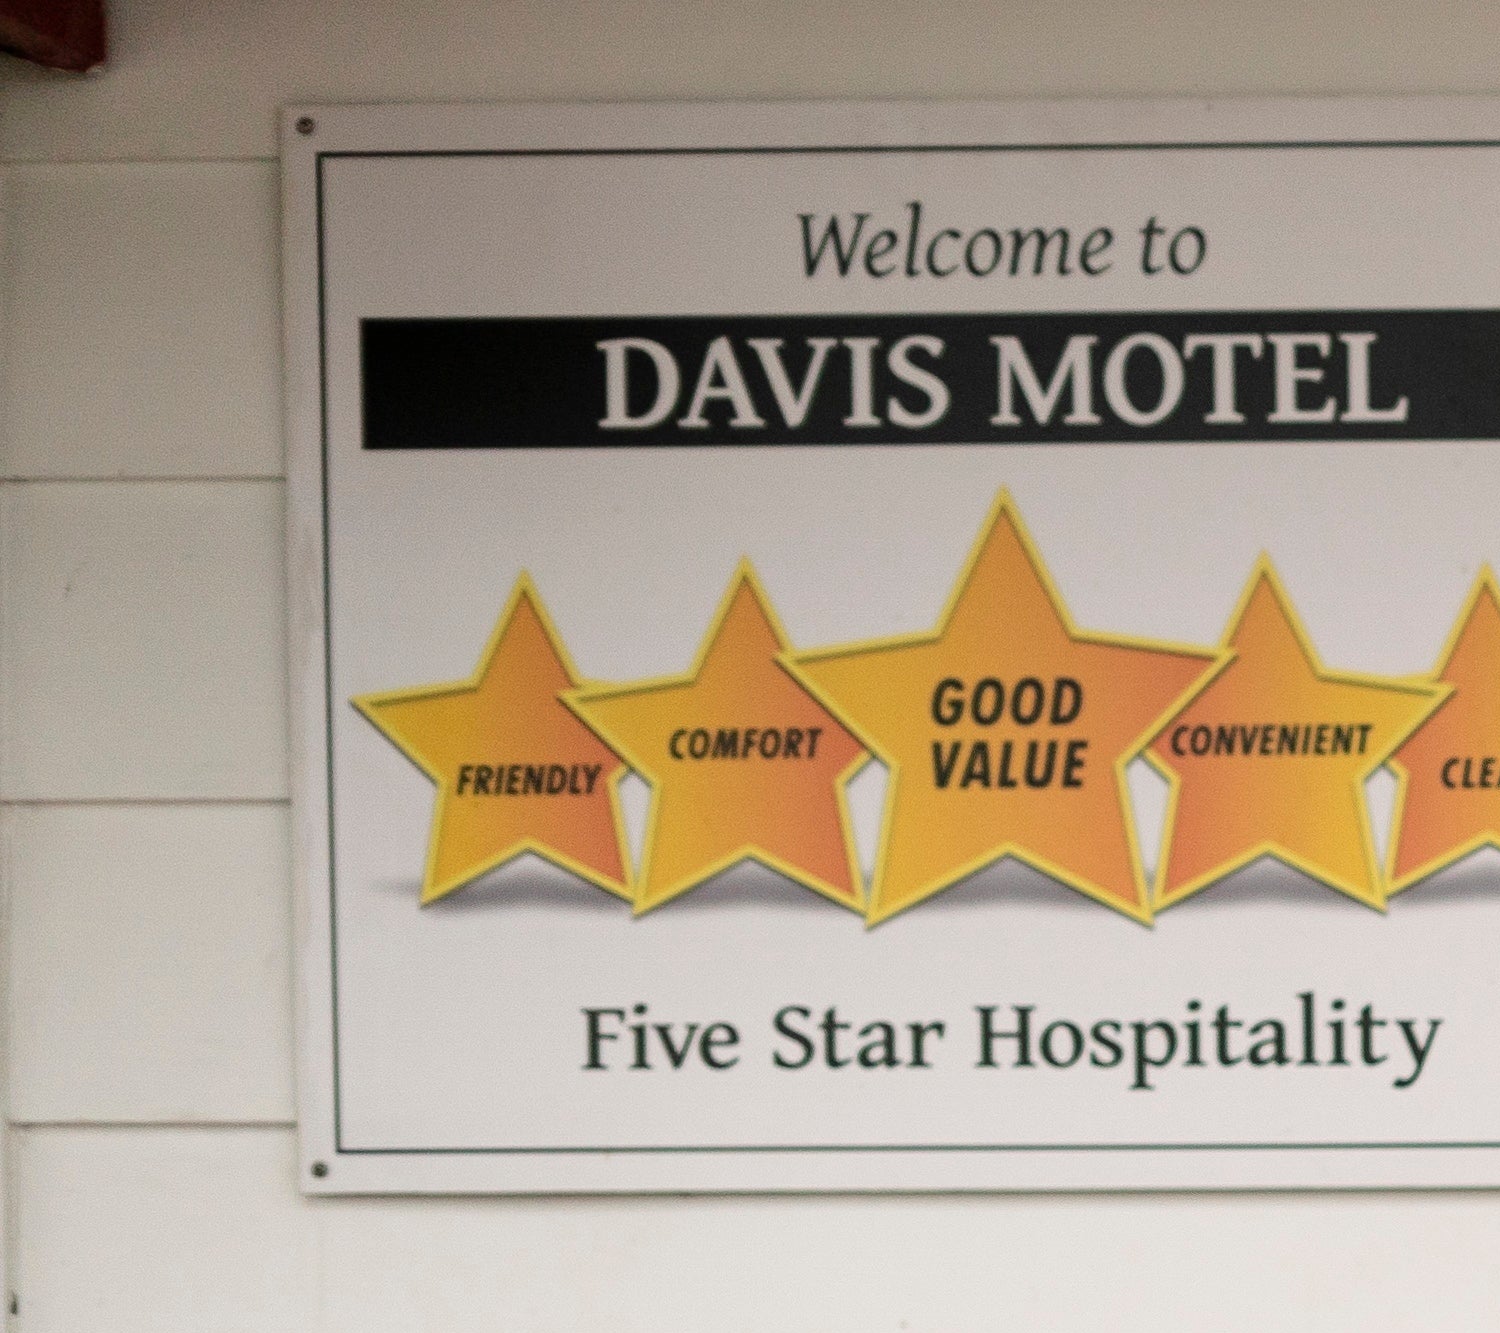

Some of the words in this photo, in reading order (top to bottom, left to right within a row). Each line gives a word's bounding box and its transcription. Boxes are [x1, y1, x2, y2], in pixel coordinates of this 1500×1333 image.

[798, 200, 1114, 279] Welcome
[1140, 217, 1207, 276] to
[597, 334, 950, 428] DAVIS
[991, 332, 1409, 426] MOTEL
[932, 677, 1083, 727] GOOD
[670, 728, 822, 759] COMFORT
[933, 740, 1088, 789] VALUE
[1170, 725, 1370, 757] CONVENIENT
[457, 763, 601, 797] FRIENDLY
[581, 1003, 740, 1070] Five
[773, 1006, 945, 1070] Star
[977, 991, 1441, 1090] Hospitality
